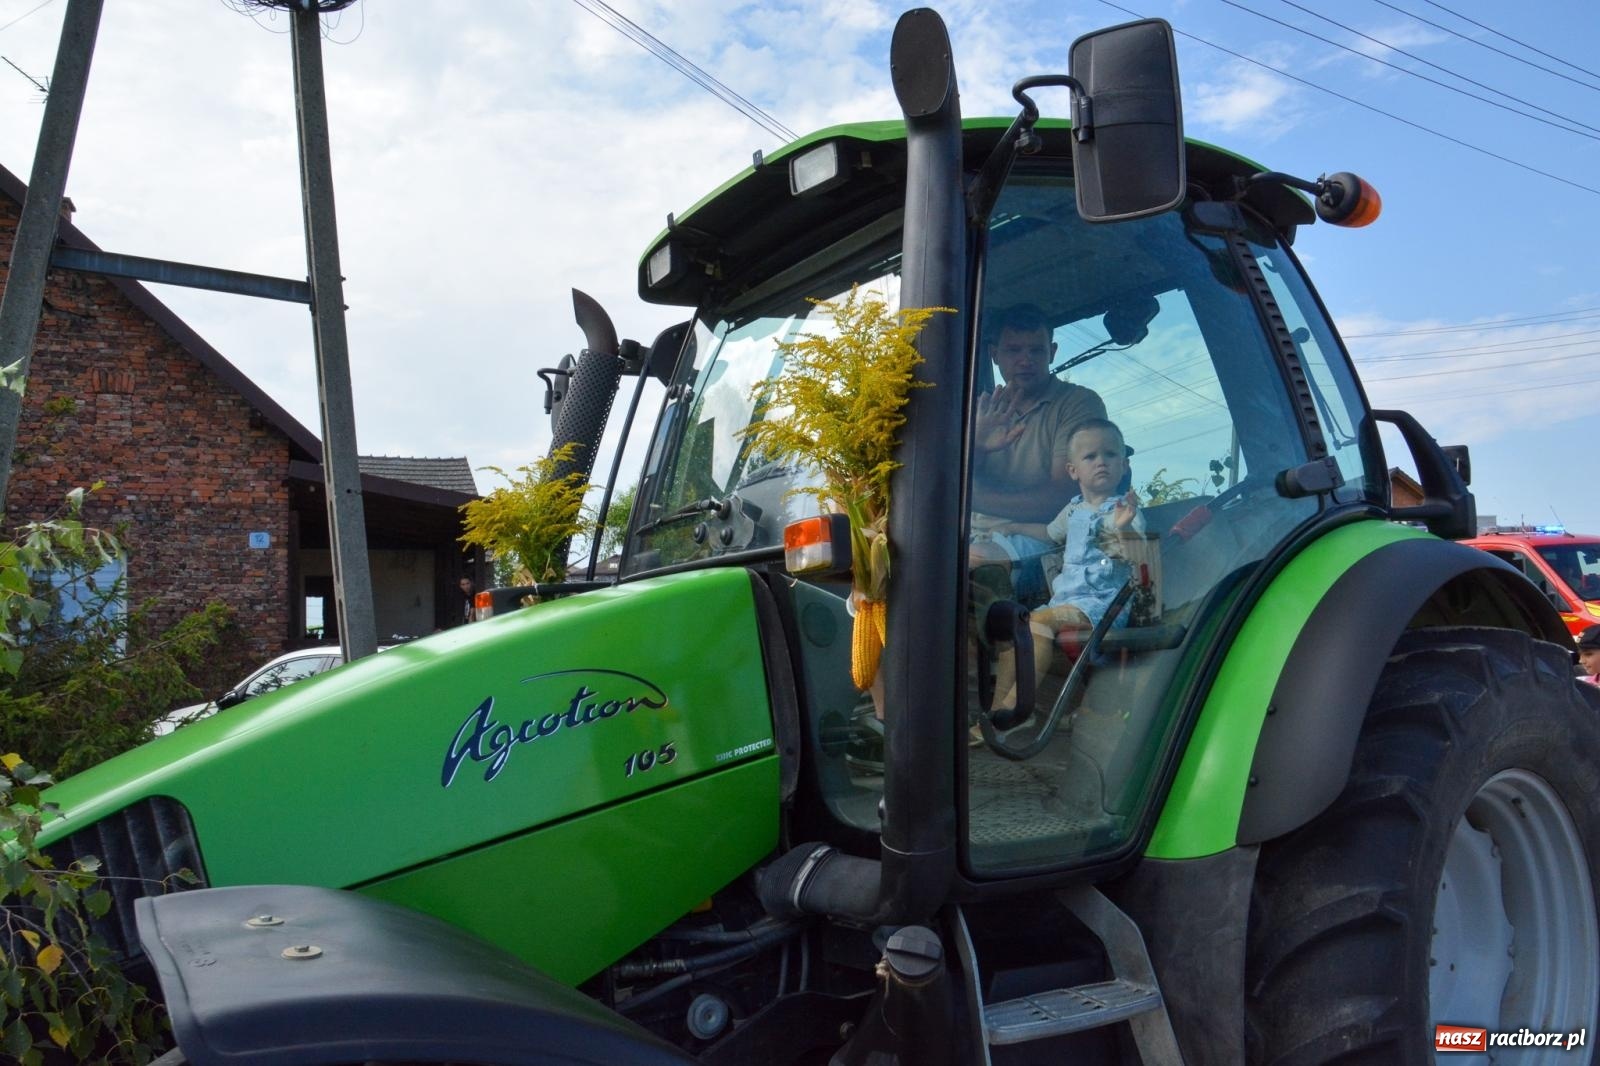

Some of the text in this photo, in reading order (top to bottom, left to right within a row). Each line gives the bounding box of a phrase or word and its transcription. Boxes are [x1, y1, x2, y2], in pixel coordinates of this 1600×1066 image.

[440, 669, 668, 788] Agrotron
[734, 738, 773, 757] PROTECTED
[622, 740, 679, 779] 105
